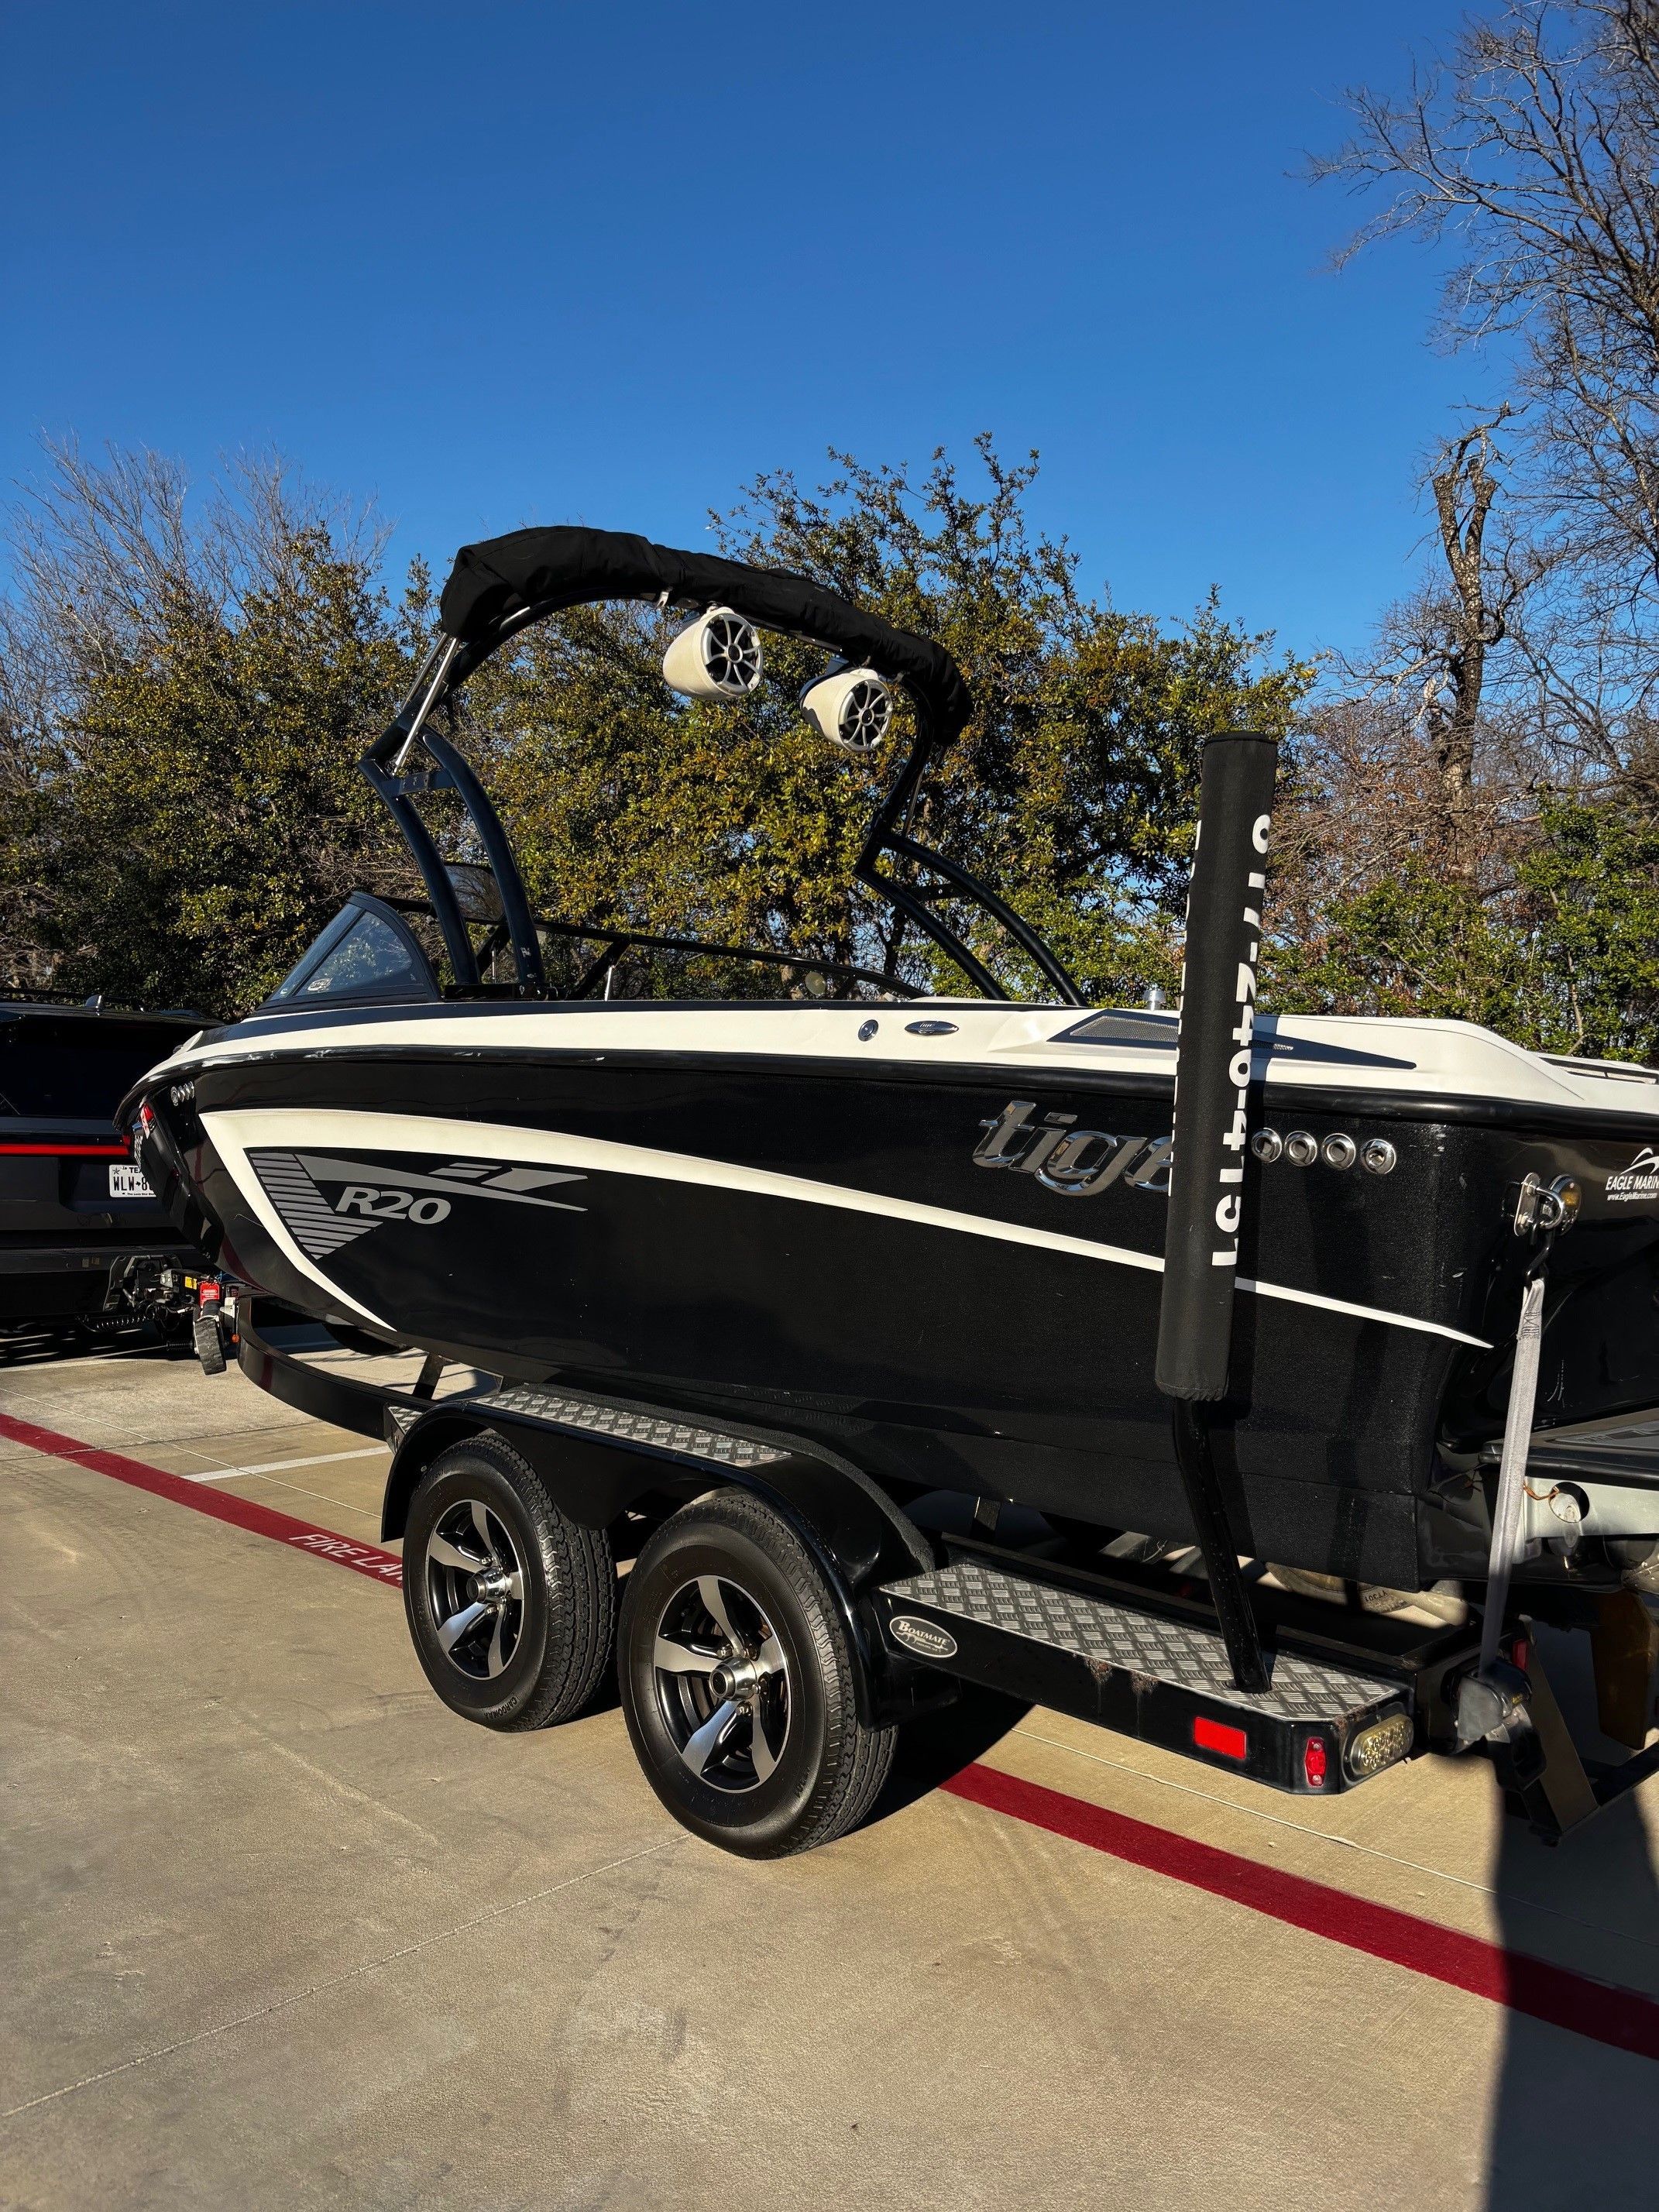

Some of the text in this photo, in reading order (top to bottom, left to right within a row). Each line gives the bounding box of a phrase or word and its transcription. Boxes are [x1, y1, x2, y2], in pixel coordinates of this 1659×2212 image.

[1605, 1175, 1659, 1190] EAGLE MARIN
[335, 1186, 452, 1224] R20
[288, 1534, 370, 1558] FIRE
